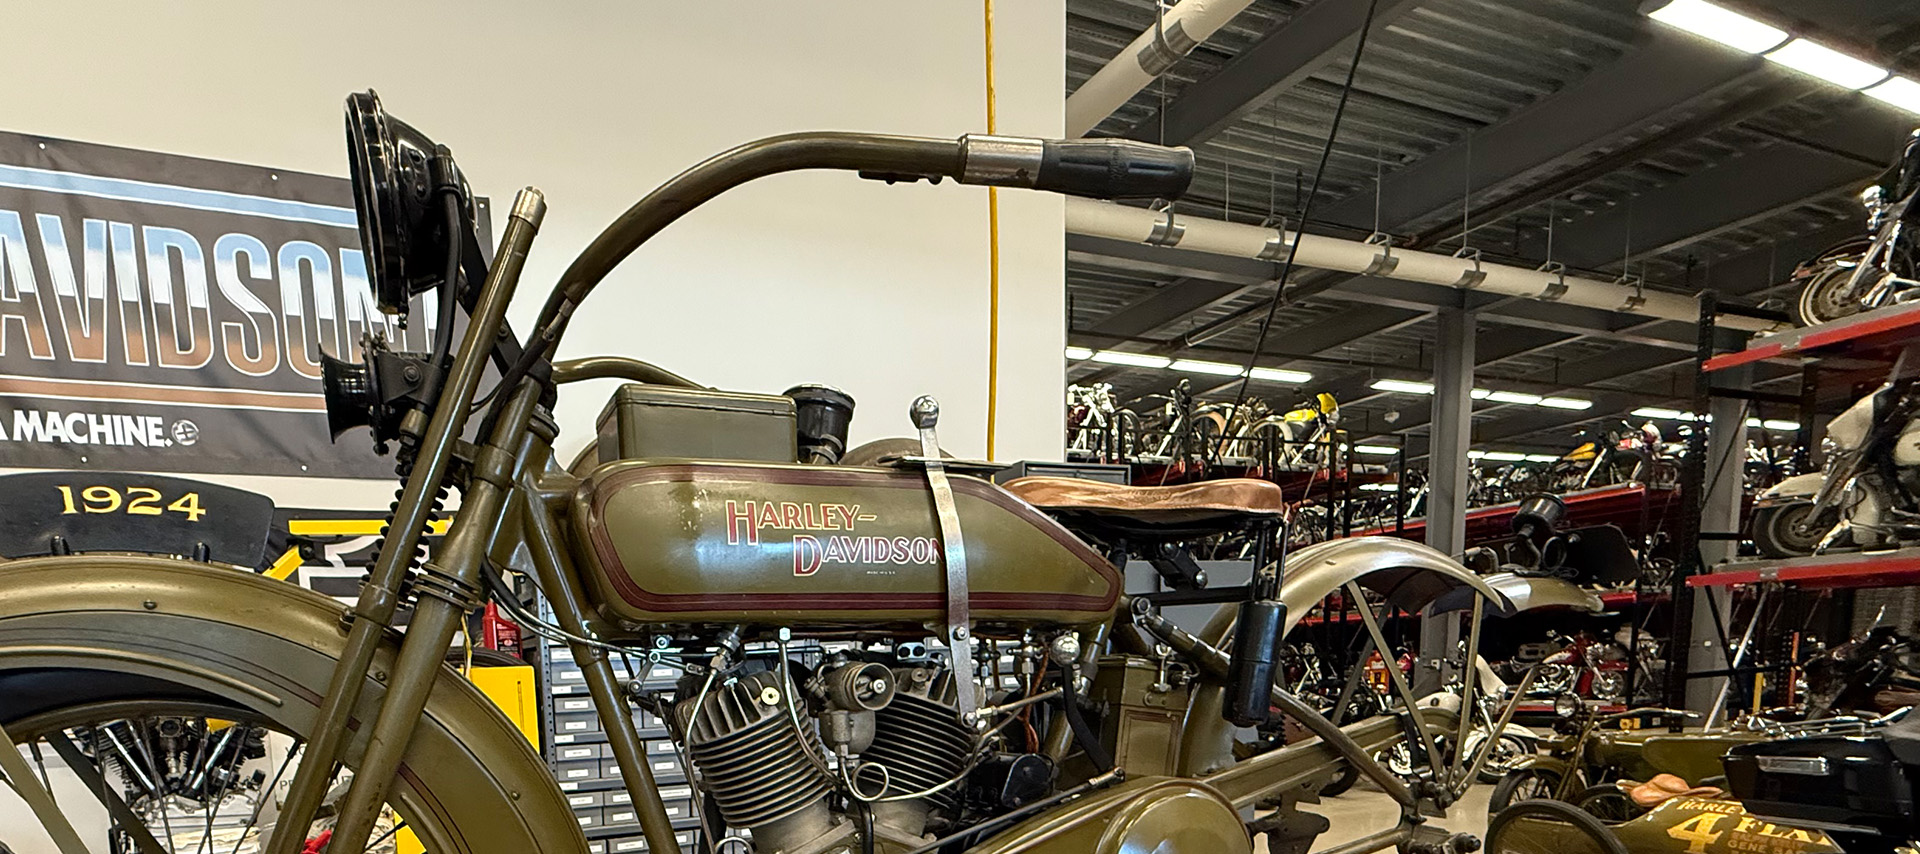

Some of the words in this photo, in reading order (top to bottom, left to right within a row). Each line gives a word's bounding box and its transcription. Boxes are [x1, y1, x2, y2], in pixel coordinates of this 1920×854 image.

[13, 410, 173, 447] MACHINE.
[55, 485, 206, 522] 1924
[725, 500, 877, 546] HARLEY-
[1667, 813, 1729, 854] 4
